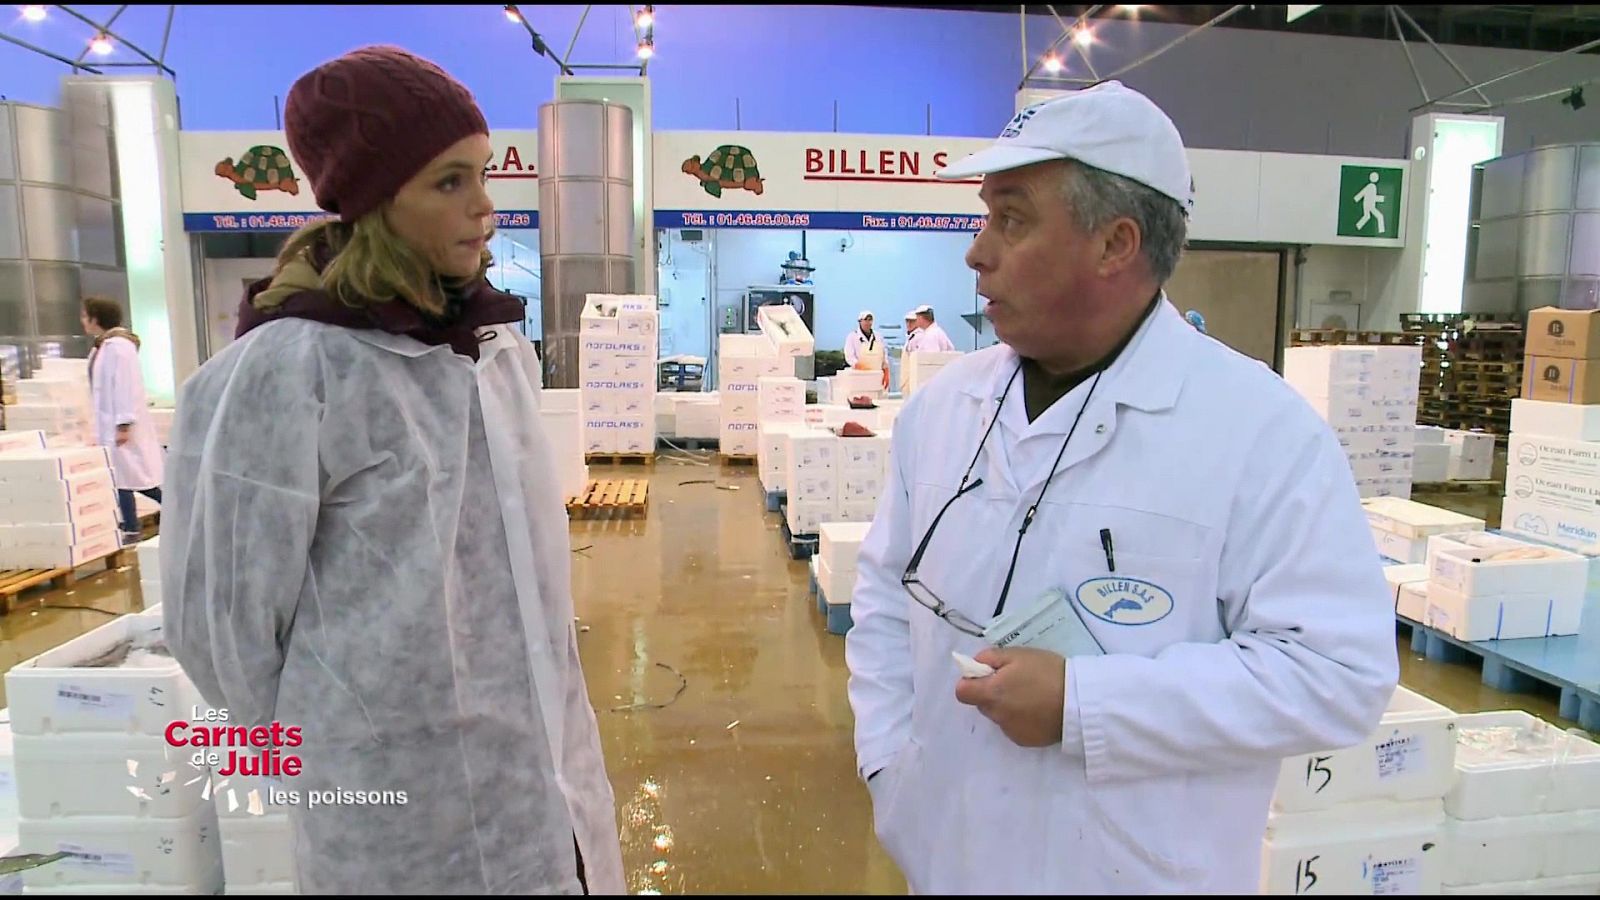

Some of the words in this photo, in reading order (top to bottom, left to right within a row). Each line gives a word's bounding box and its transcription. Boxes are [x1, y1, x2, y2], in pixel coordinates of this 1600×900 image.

[805, 148, 920, 176] BILLEN
[716, 213, 810, 226] 01.46.86.00.65
[1096, 581, 1130, 598] BILLEN
[1305, 756, 1334, 794] 15
[1295, 855, 1320, 895] 15
